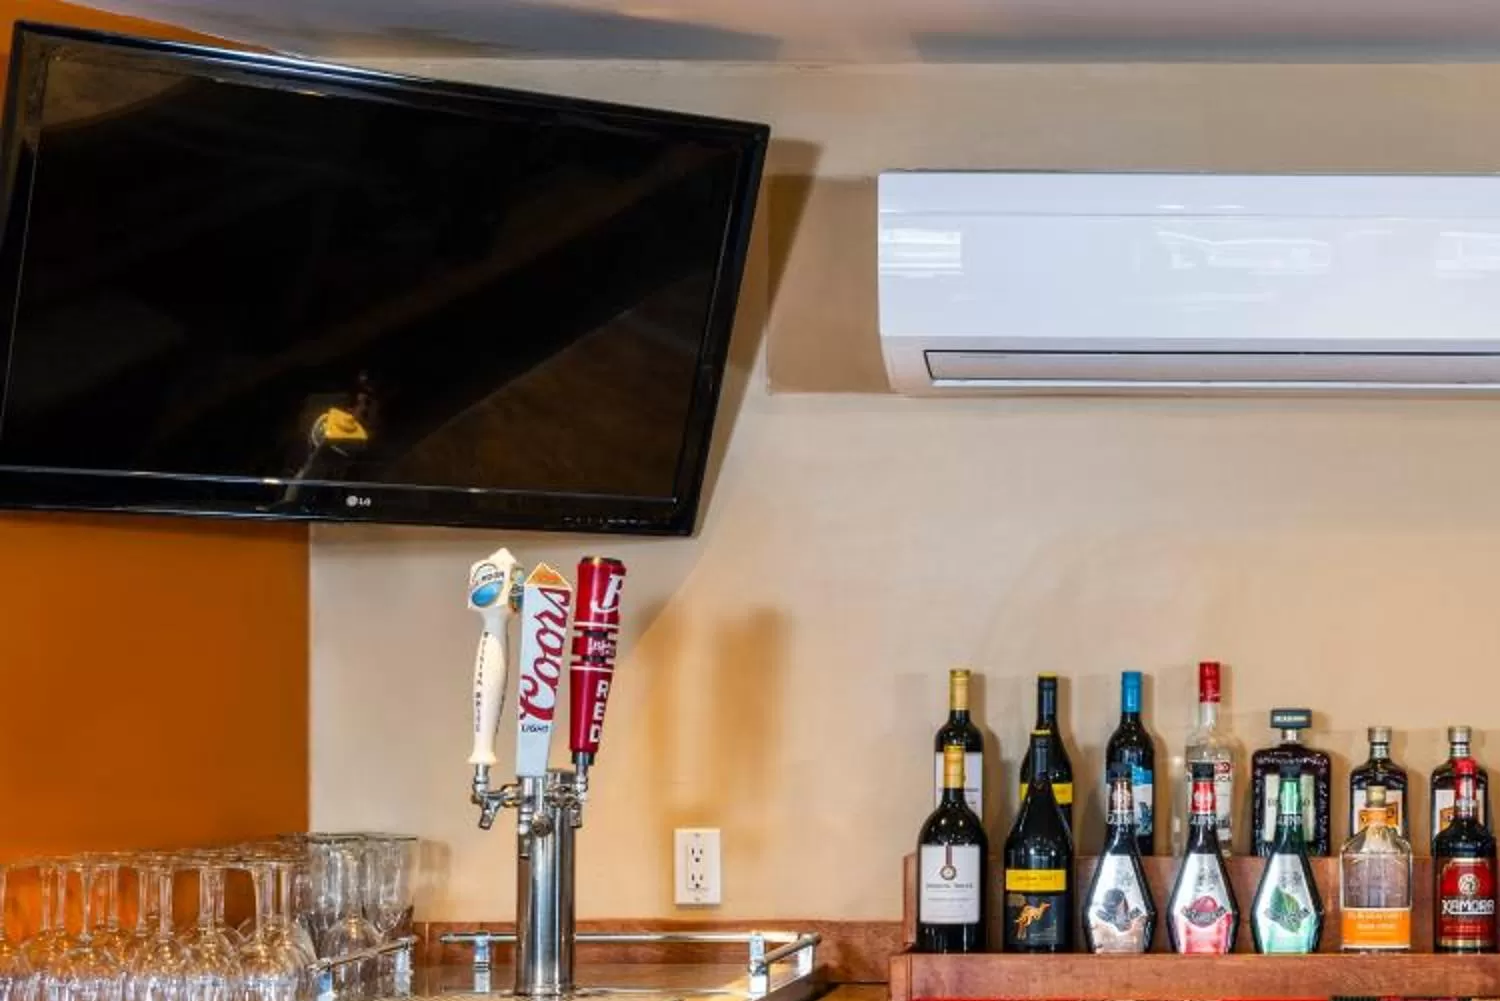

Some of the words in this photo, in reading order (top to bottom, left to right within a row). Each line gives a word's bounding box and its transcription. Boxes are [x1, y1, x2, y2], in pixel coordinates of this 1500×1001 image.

[518, 587, 572, 721] Coors
[520, 724, 550, 734] LIGHT
[589, 679, 609, 744] RED
